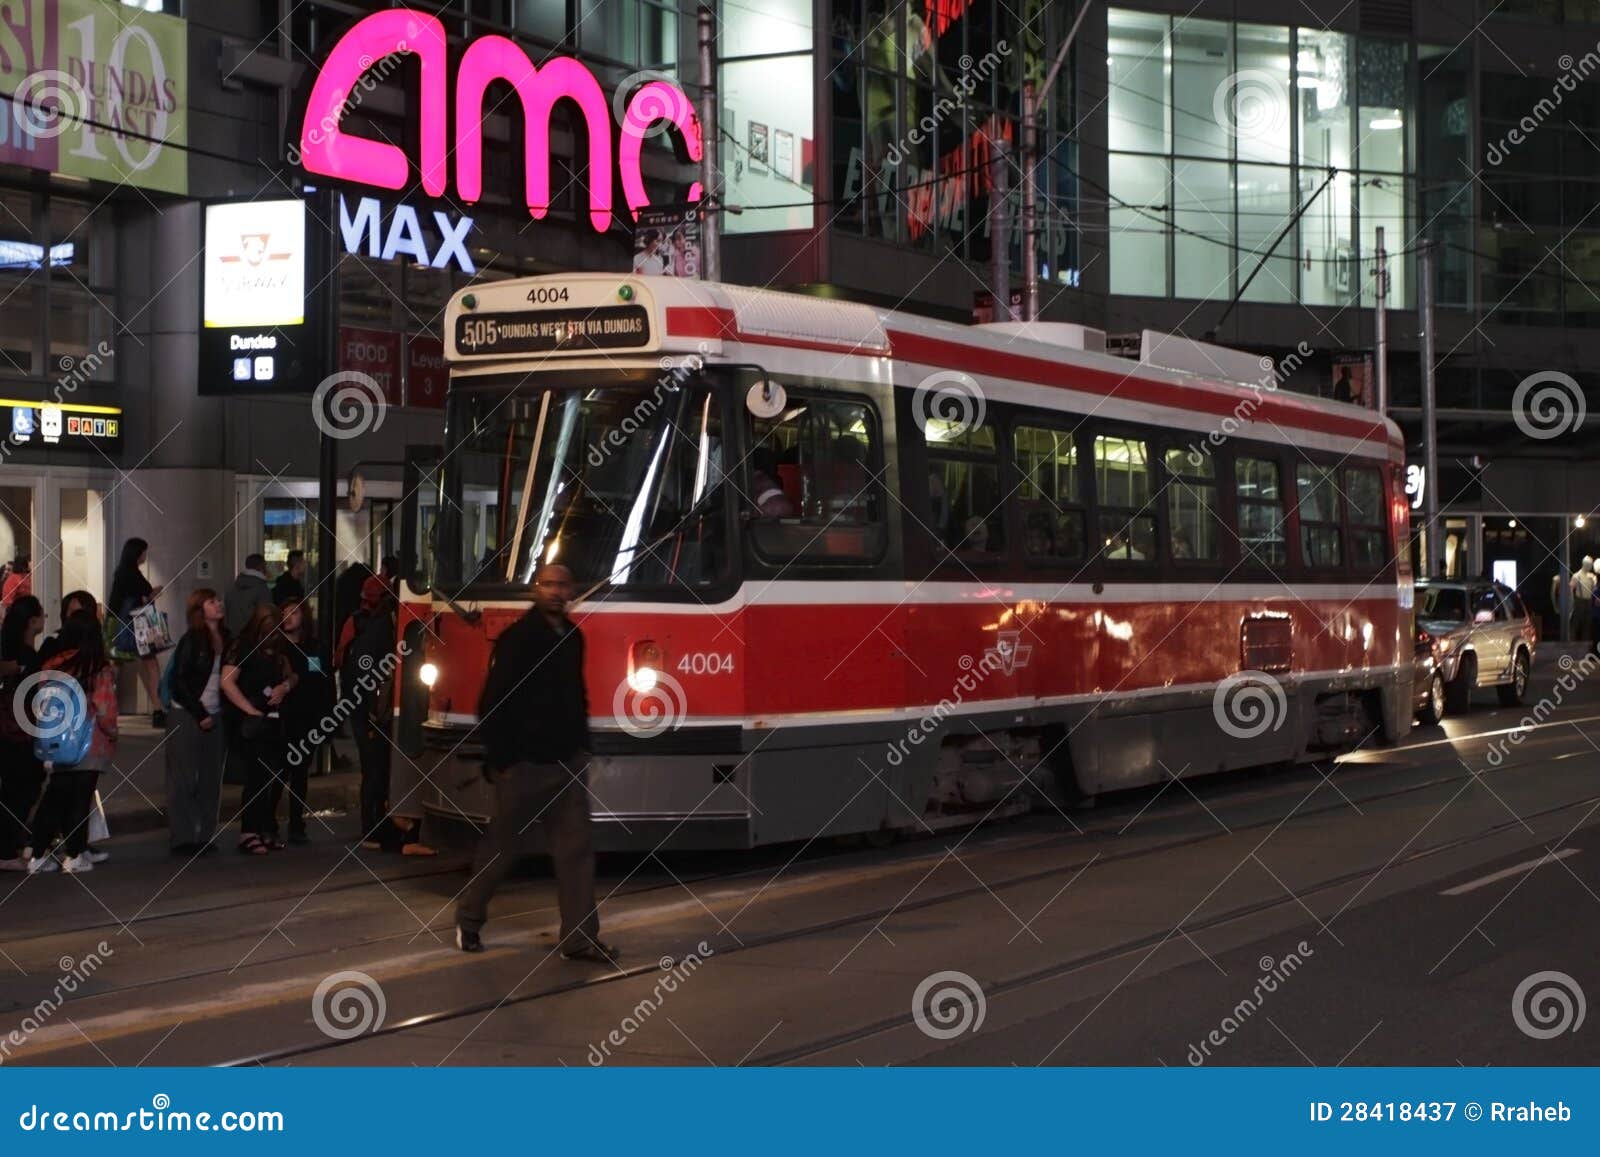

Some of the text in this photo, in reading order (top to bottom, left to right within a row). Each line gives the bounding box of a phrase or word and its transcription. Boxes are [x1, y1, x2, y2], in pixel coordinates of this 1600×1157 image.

[67, 14, 168, 170] 10
[68, 56, 177, 114] DUNDAS
[88, 98, 157, 146] EAST
[304, 187, 476, 273] MAX
[526, 287, 569, 304] 4004
[464, 320, 497, 346] 505
[501, 322, 538, 338] DUNDAS
[540, 321, 566, 336] WEST
[587, 319, 603, 334] VIA
[604, 318, 642, 333] DUNDAS
[346, 341, 388, 362] FOOD
[68, 417, 118, 436] PATH
[677, 653, 734, 674] 4004
